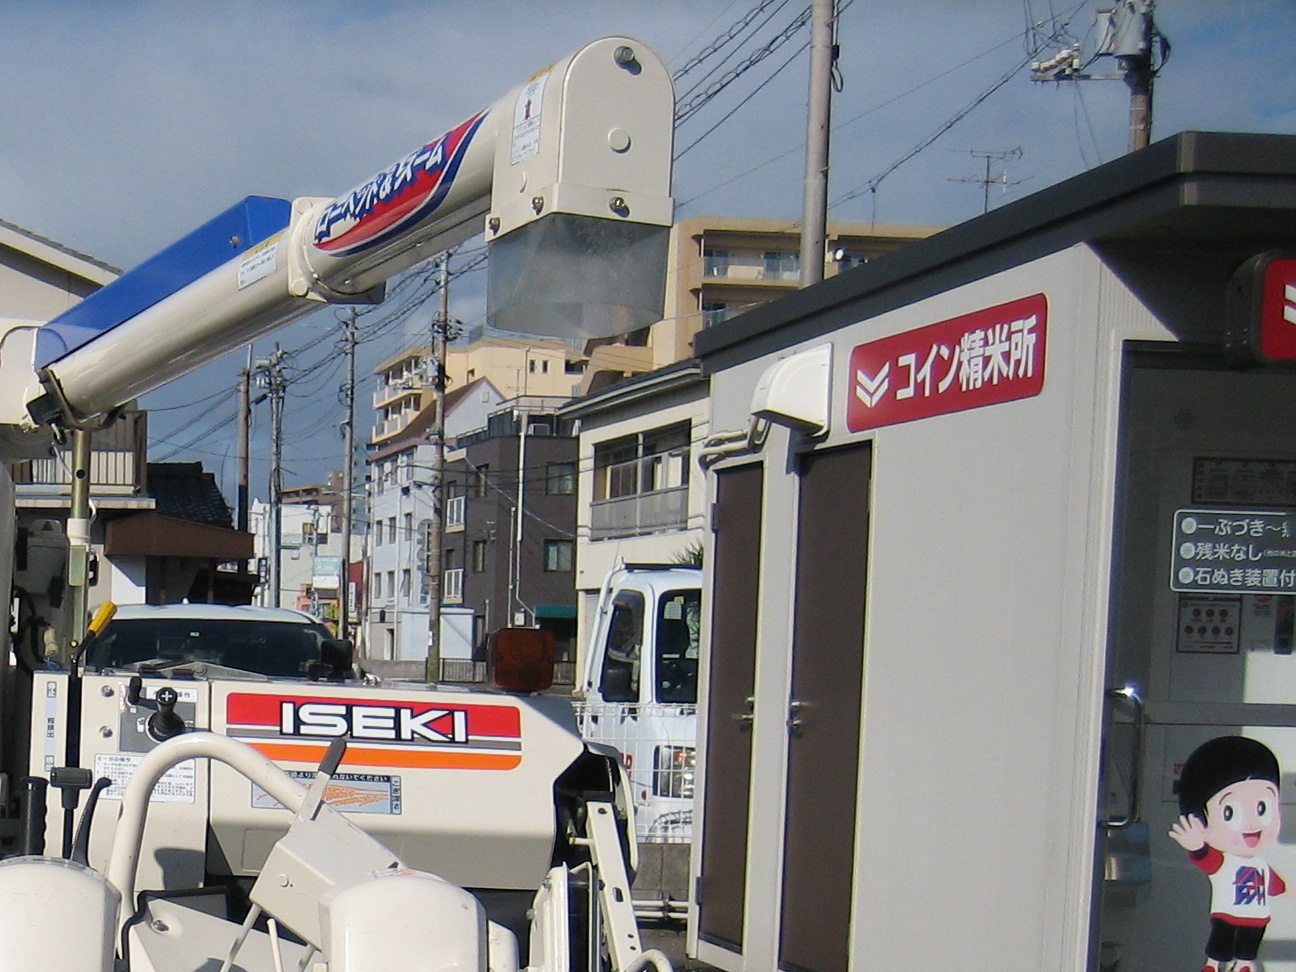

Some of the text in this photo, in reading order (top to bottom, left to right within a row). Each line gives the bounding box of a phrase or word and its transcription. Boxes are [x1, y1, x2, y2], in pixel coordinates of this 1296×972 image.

[895, 315, 1038, 401] コイン精米所
[280, 700, 470, 743] ISEKI
